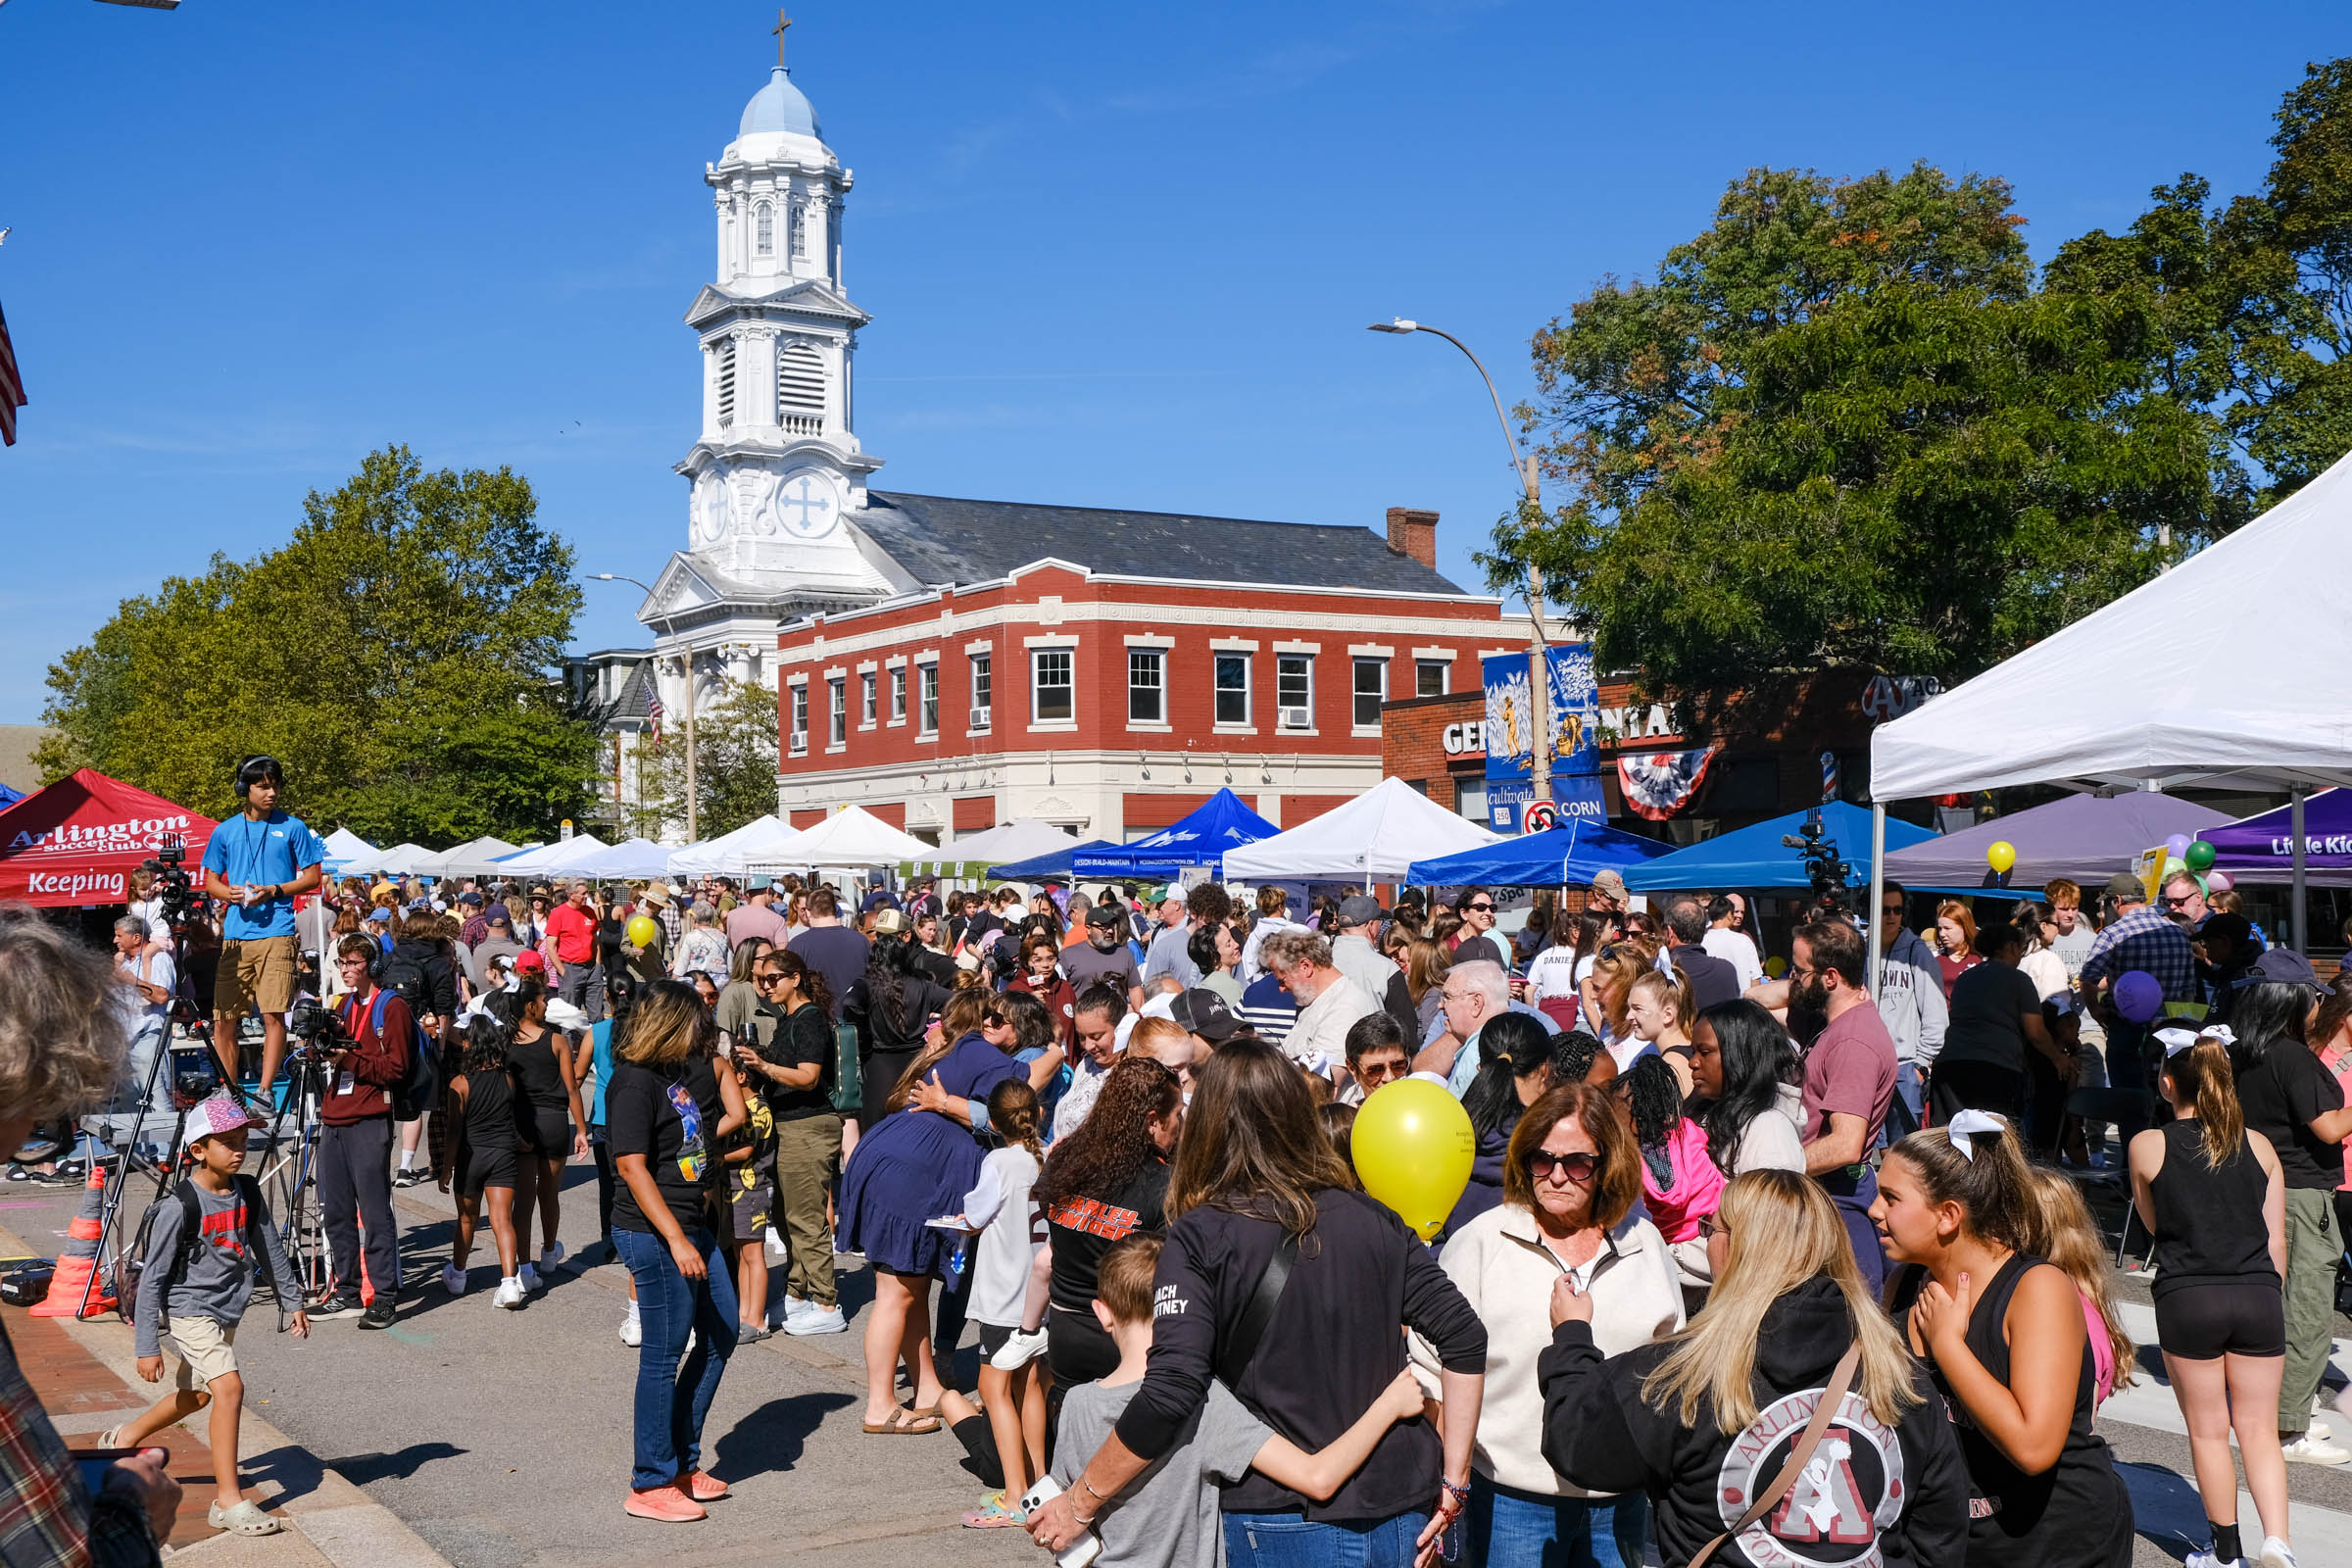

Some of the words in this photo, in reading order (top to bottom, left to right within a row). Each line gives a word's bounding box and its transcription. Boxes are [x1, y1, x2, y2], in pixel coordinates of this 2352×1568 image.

[1489, 786, 1534, 805] cultivate
[1496, 811, 1509, 820] 250
[1561, 801, 1601, 816] CORN
[8, 815, 190, 848] Arlington
[43, 838, 109, 853] soccer
[97, 840, 143, 853] club
[2272, 836, 2323, 856] Lile
[28, 868, 124, 898] Keeping
[1880, 969, 1910, 990] OWN
[203, 1205, 248, 1237] PUMA
[1061, 1195, 1143, 1227] ARLEY-
[1153, 1284, 1177, 1304] ACH
[1738, 1393, 1896, 1465] ARLINTON
